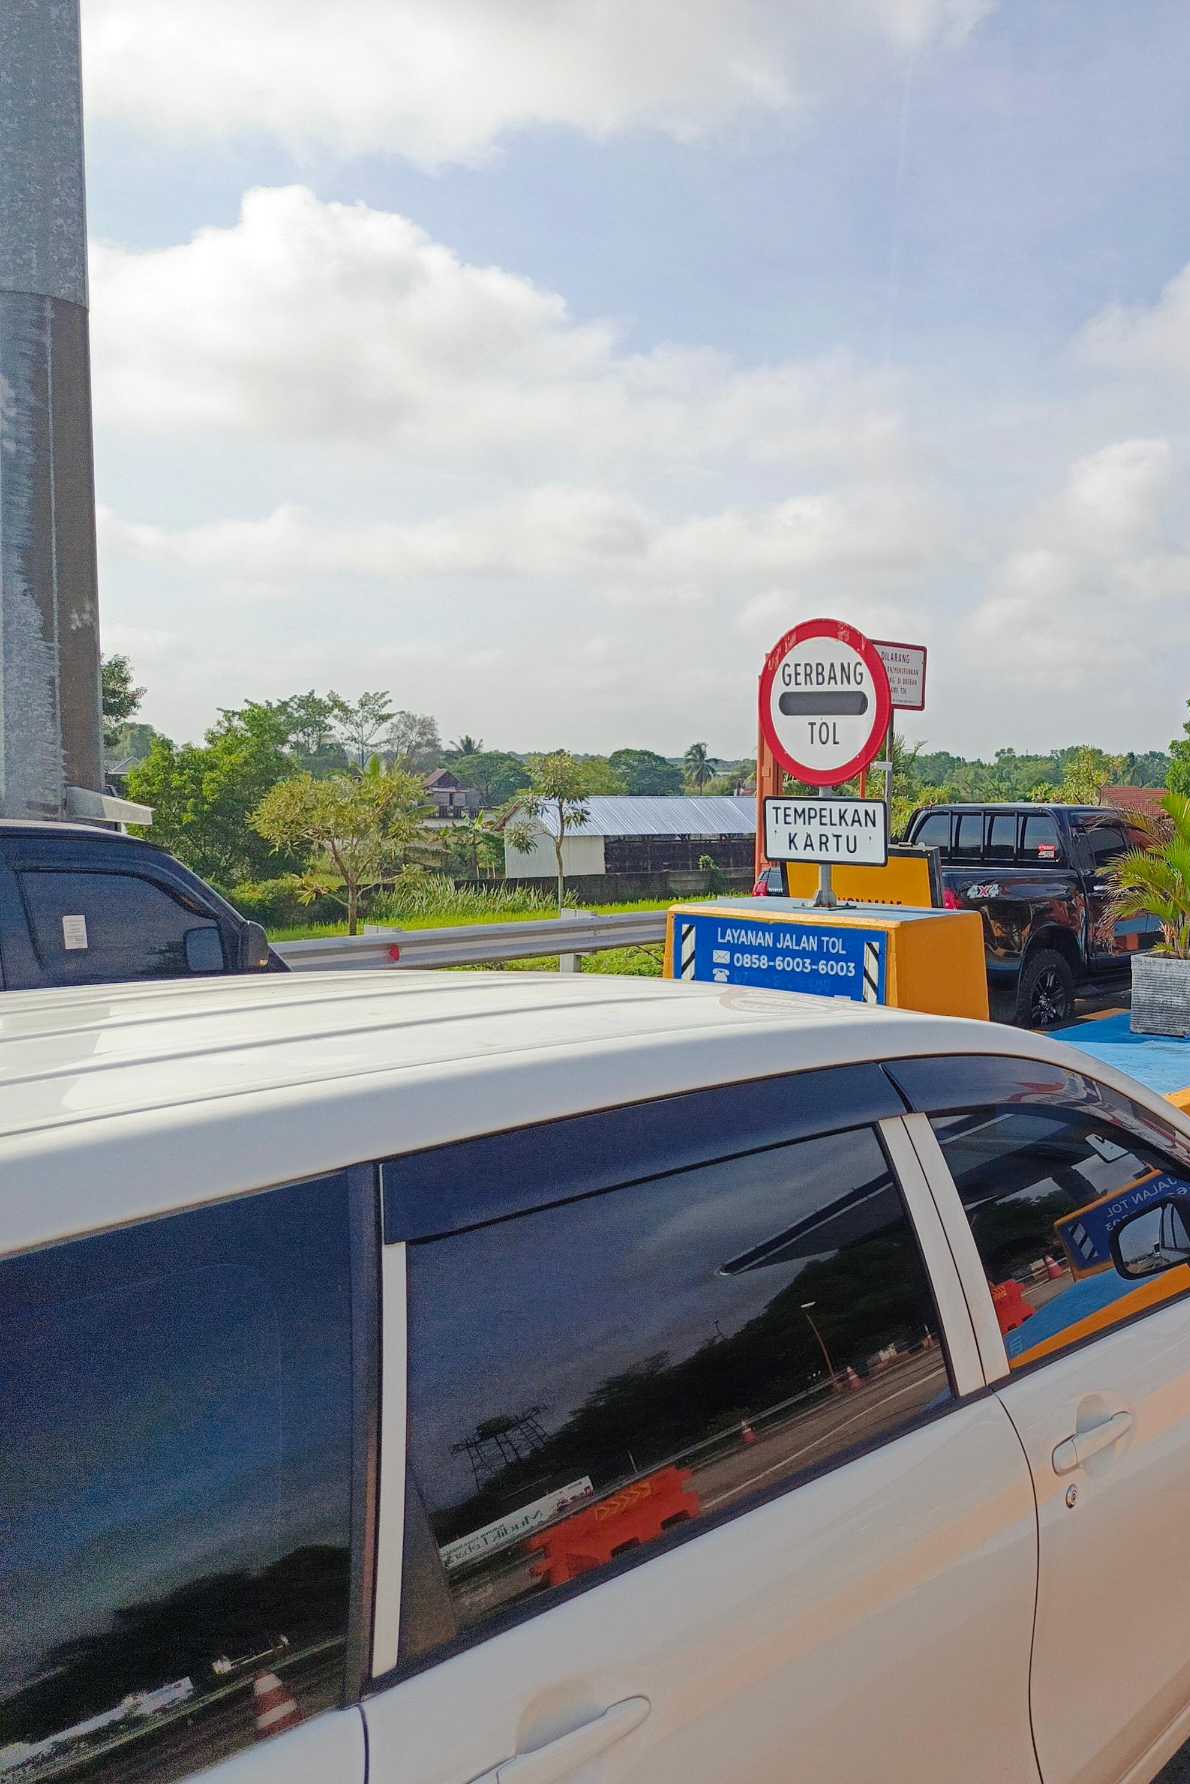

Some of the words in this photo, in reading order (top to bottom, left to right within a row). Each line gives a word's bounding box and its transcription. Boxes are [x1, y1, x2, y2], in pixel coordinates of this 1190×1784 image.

[782, 661, 864, 687] GERBANG
[807, 721, 840, 745] TOL
[772, 806, 877, 828] TEMPELKAN
[788, 832, 857, 854] KARTU
[717, 927, 774, 948] LAYANAN
[776, 933, 818, 952] JALAN
[821, 936, 847, 955] TOL
[733, 952, 856, 977] 0858-6003-6003
